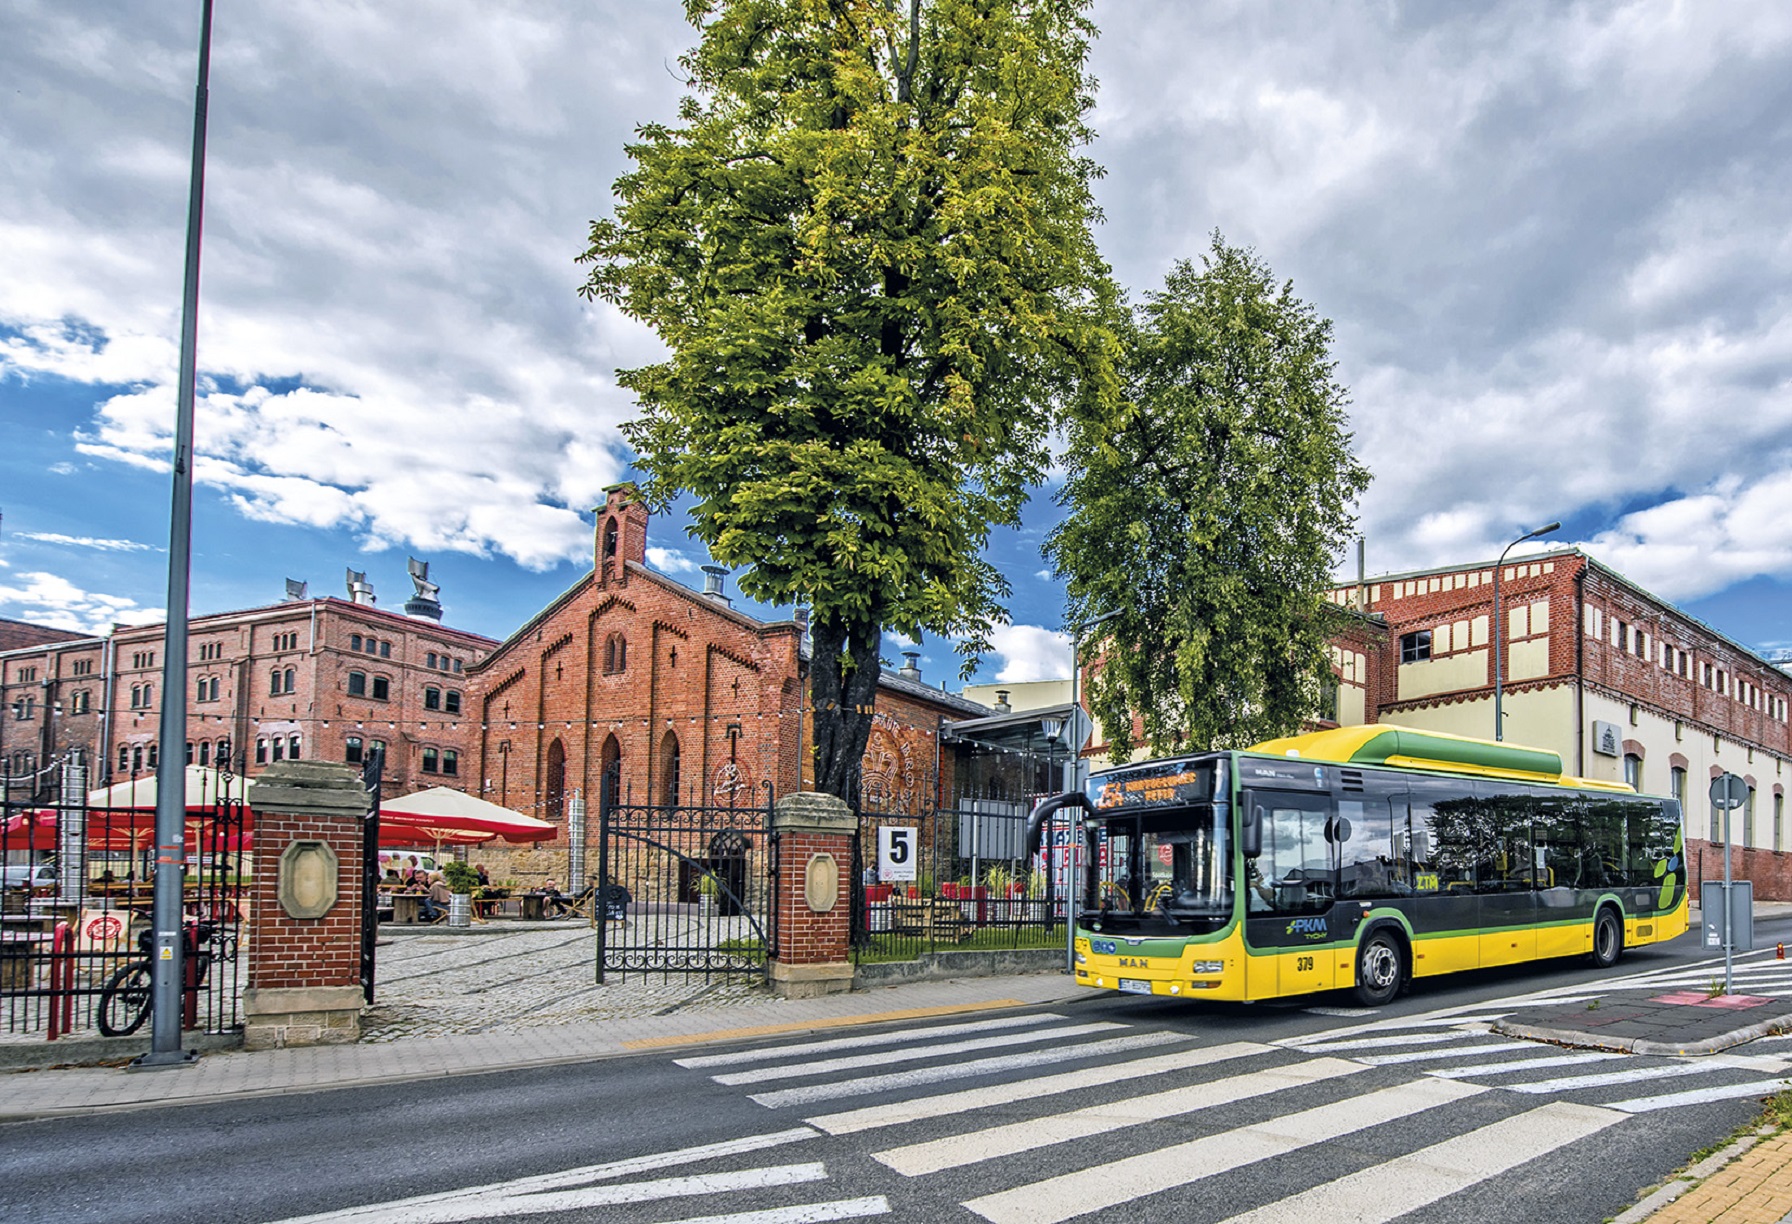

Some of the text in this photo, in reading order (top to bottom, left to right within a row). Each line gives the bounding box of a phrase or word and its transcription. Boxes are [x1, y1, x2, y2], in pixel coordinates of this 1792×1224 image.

[1255, 768, 1276, 777] MAN
[889, 831, 908, 864] 5
[1416, 874, 1439, 891] ZTM
[1294, 918, 1328, 934] PKM
[1303, 931, 1328, 940] TYCHY
[1119, 957, 1149, 968] MAN
[1297, 956, 1314, 972] 379
